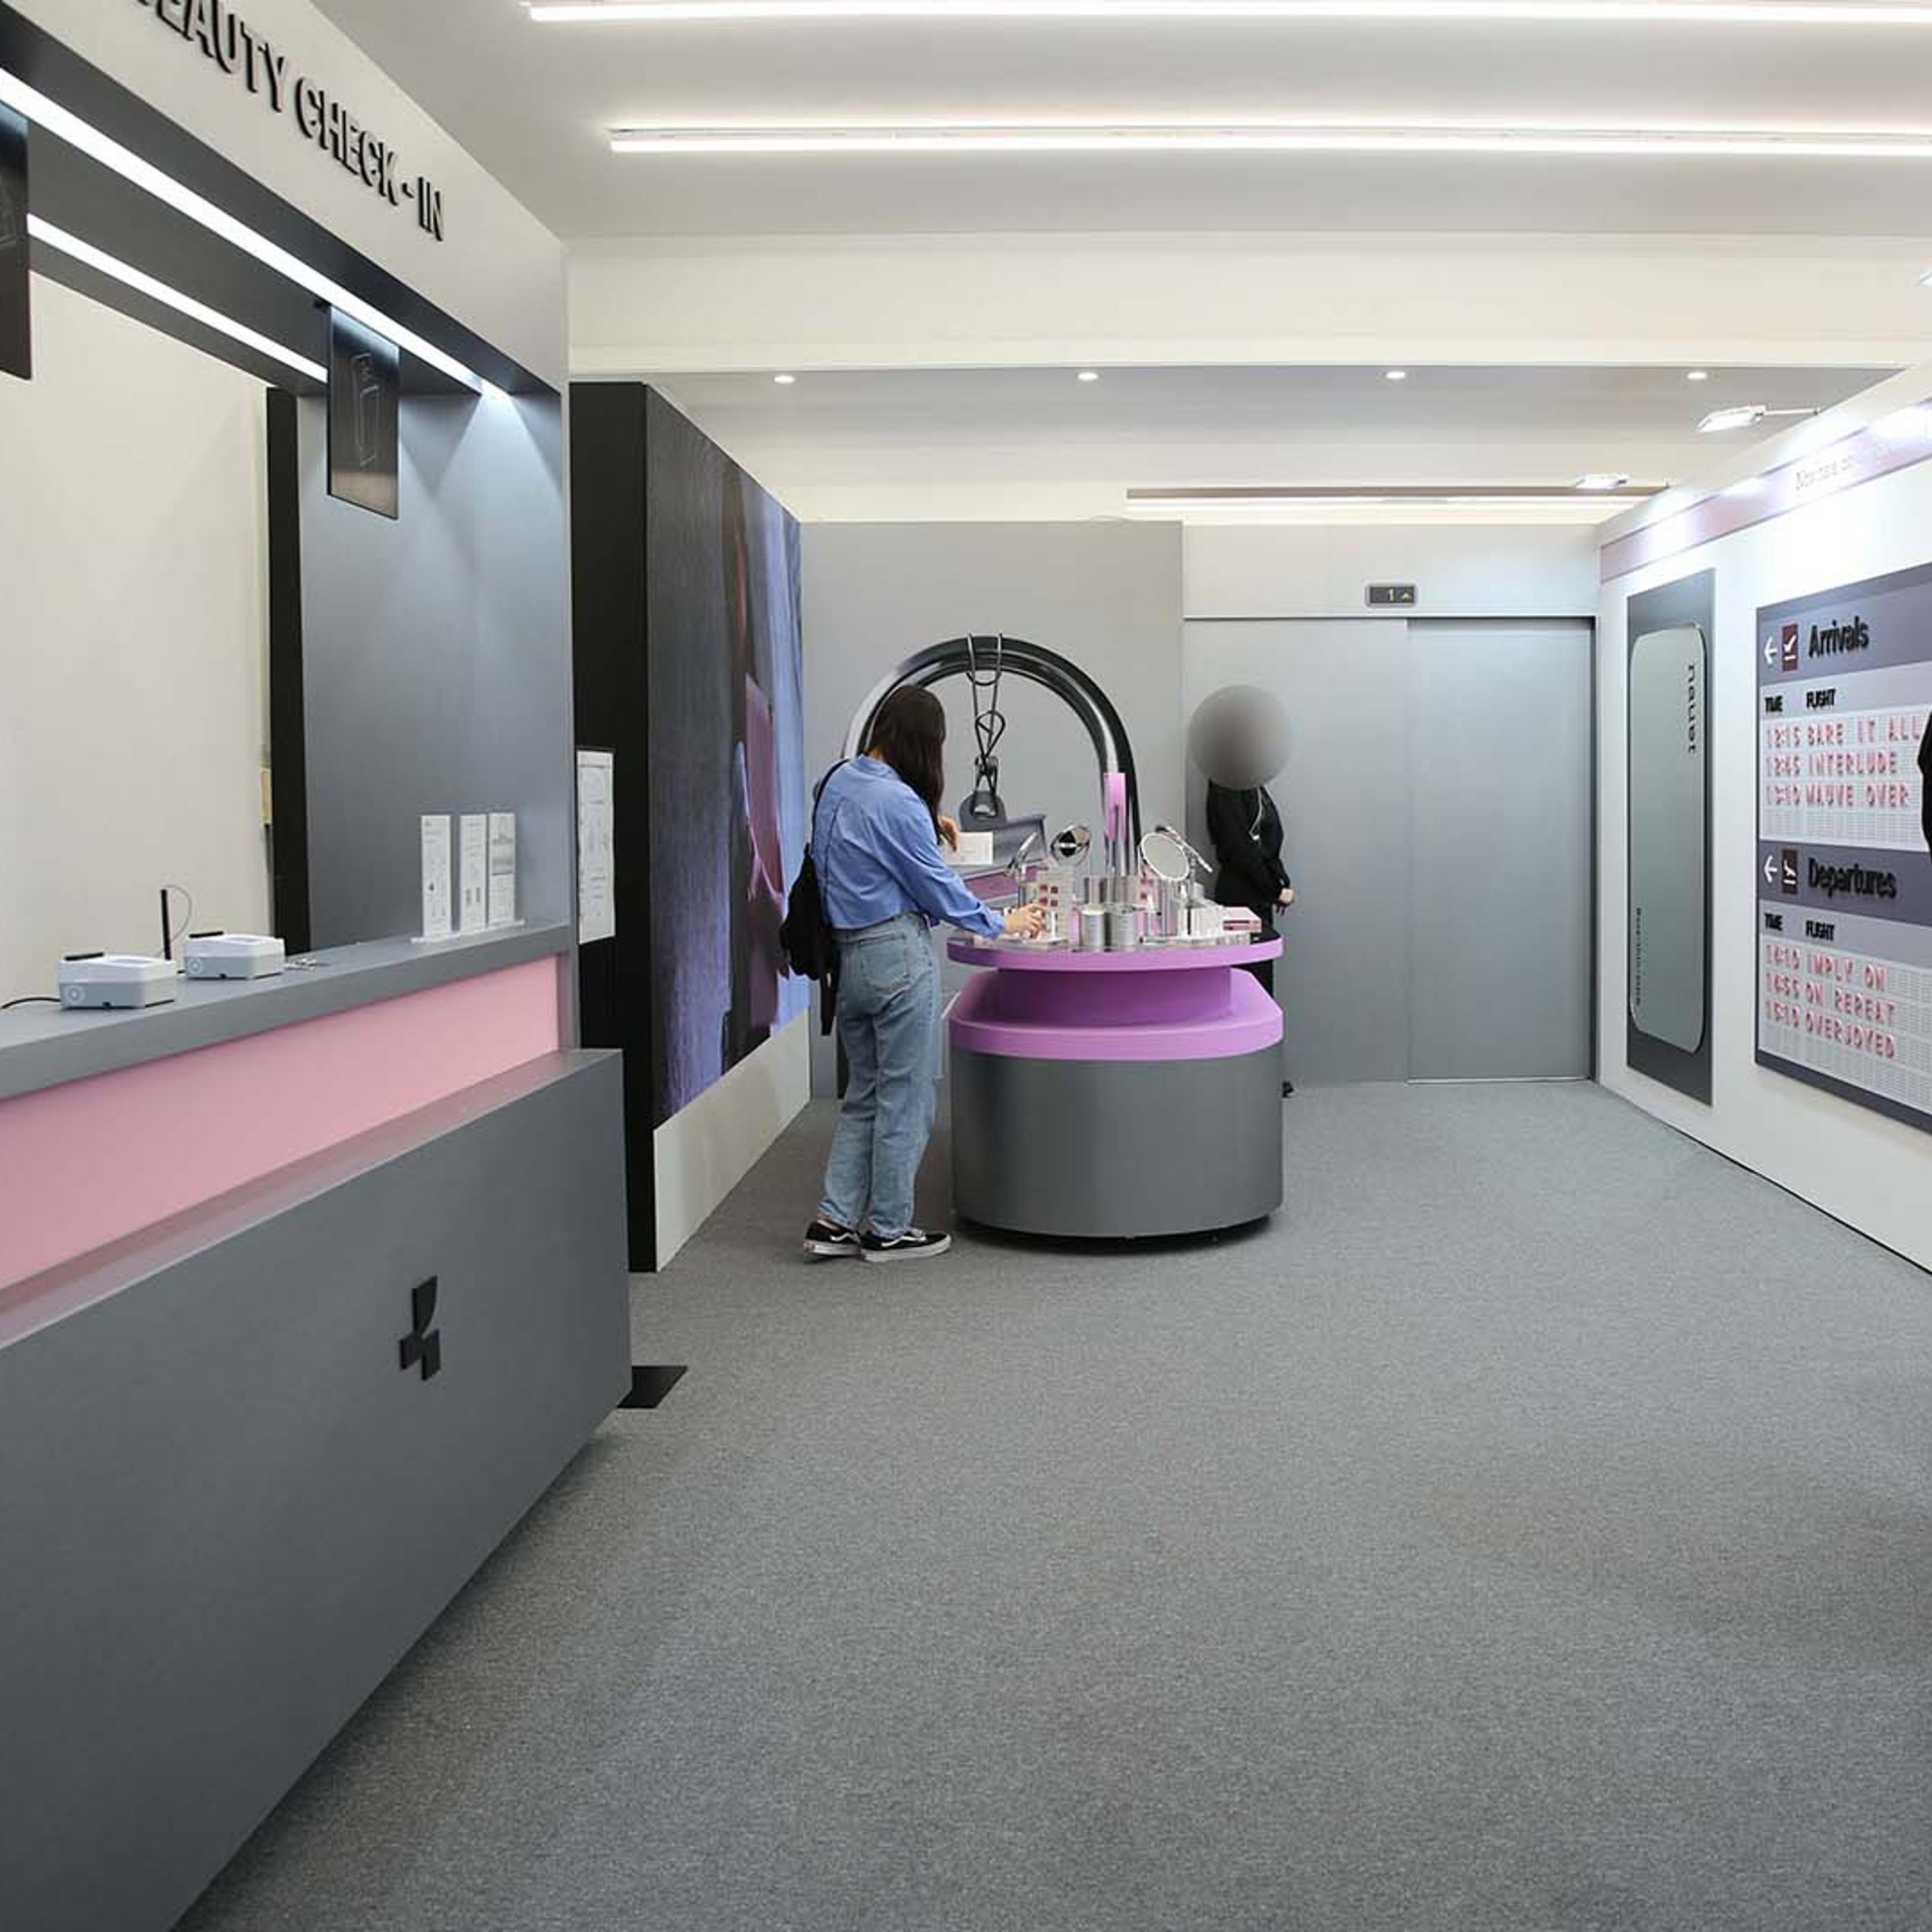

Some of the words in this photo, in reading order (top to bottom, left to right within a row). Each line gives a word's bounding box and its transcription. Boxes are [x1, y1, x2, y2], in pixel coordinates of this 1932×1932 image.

[1808, 615, 1870, 659] Arrivals
[1764, 695, 1783, 713] TIME
[1806, 688, 1836, 708] FLIGHT
[1808, 722, 1844, 746] BARE
[1857, 716, 1876, 743] IT
[1808, 751, 1897, 777] INTERLUDE
[1866, 781, 1909, 808] OVER
[1808, 857, 1897, 899] Departures
[1764, 913, 1783, 931] TIME
[1805, 920, 1835, 941] FLIGHT
[1807, 953, 1854, 984] IMPLY
[1865, 963, 1888, 992] ON
[1806, 982, 1823, 1004] ON
[1834, 988, 1896, 1026] REPEAT
[1805, 1010, 1896, 1059] OVERJOYED
